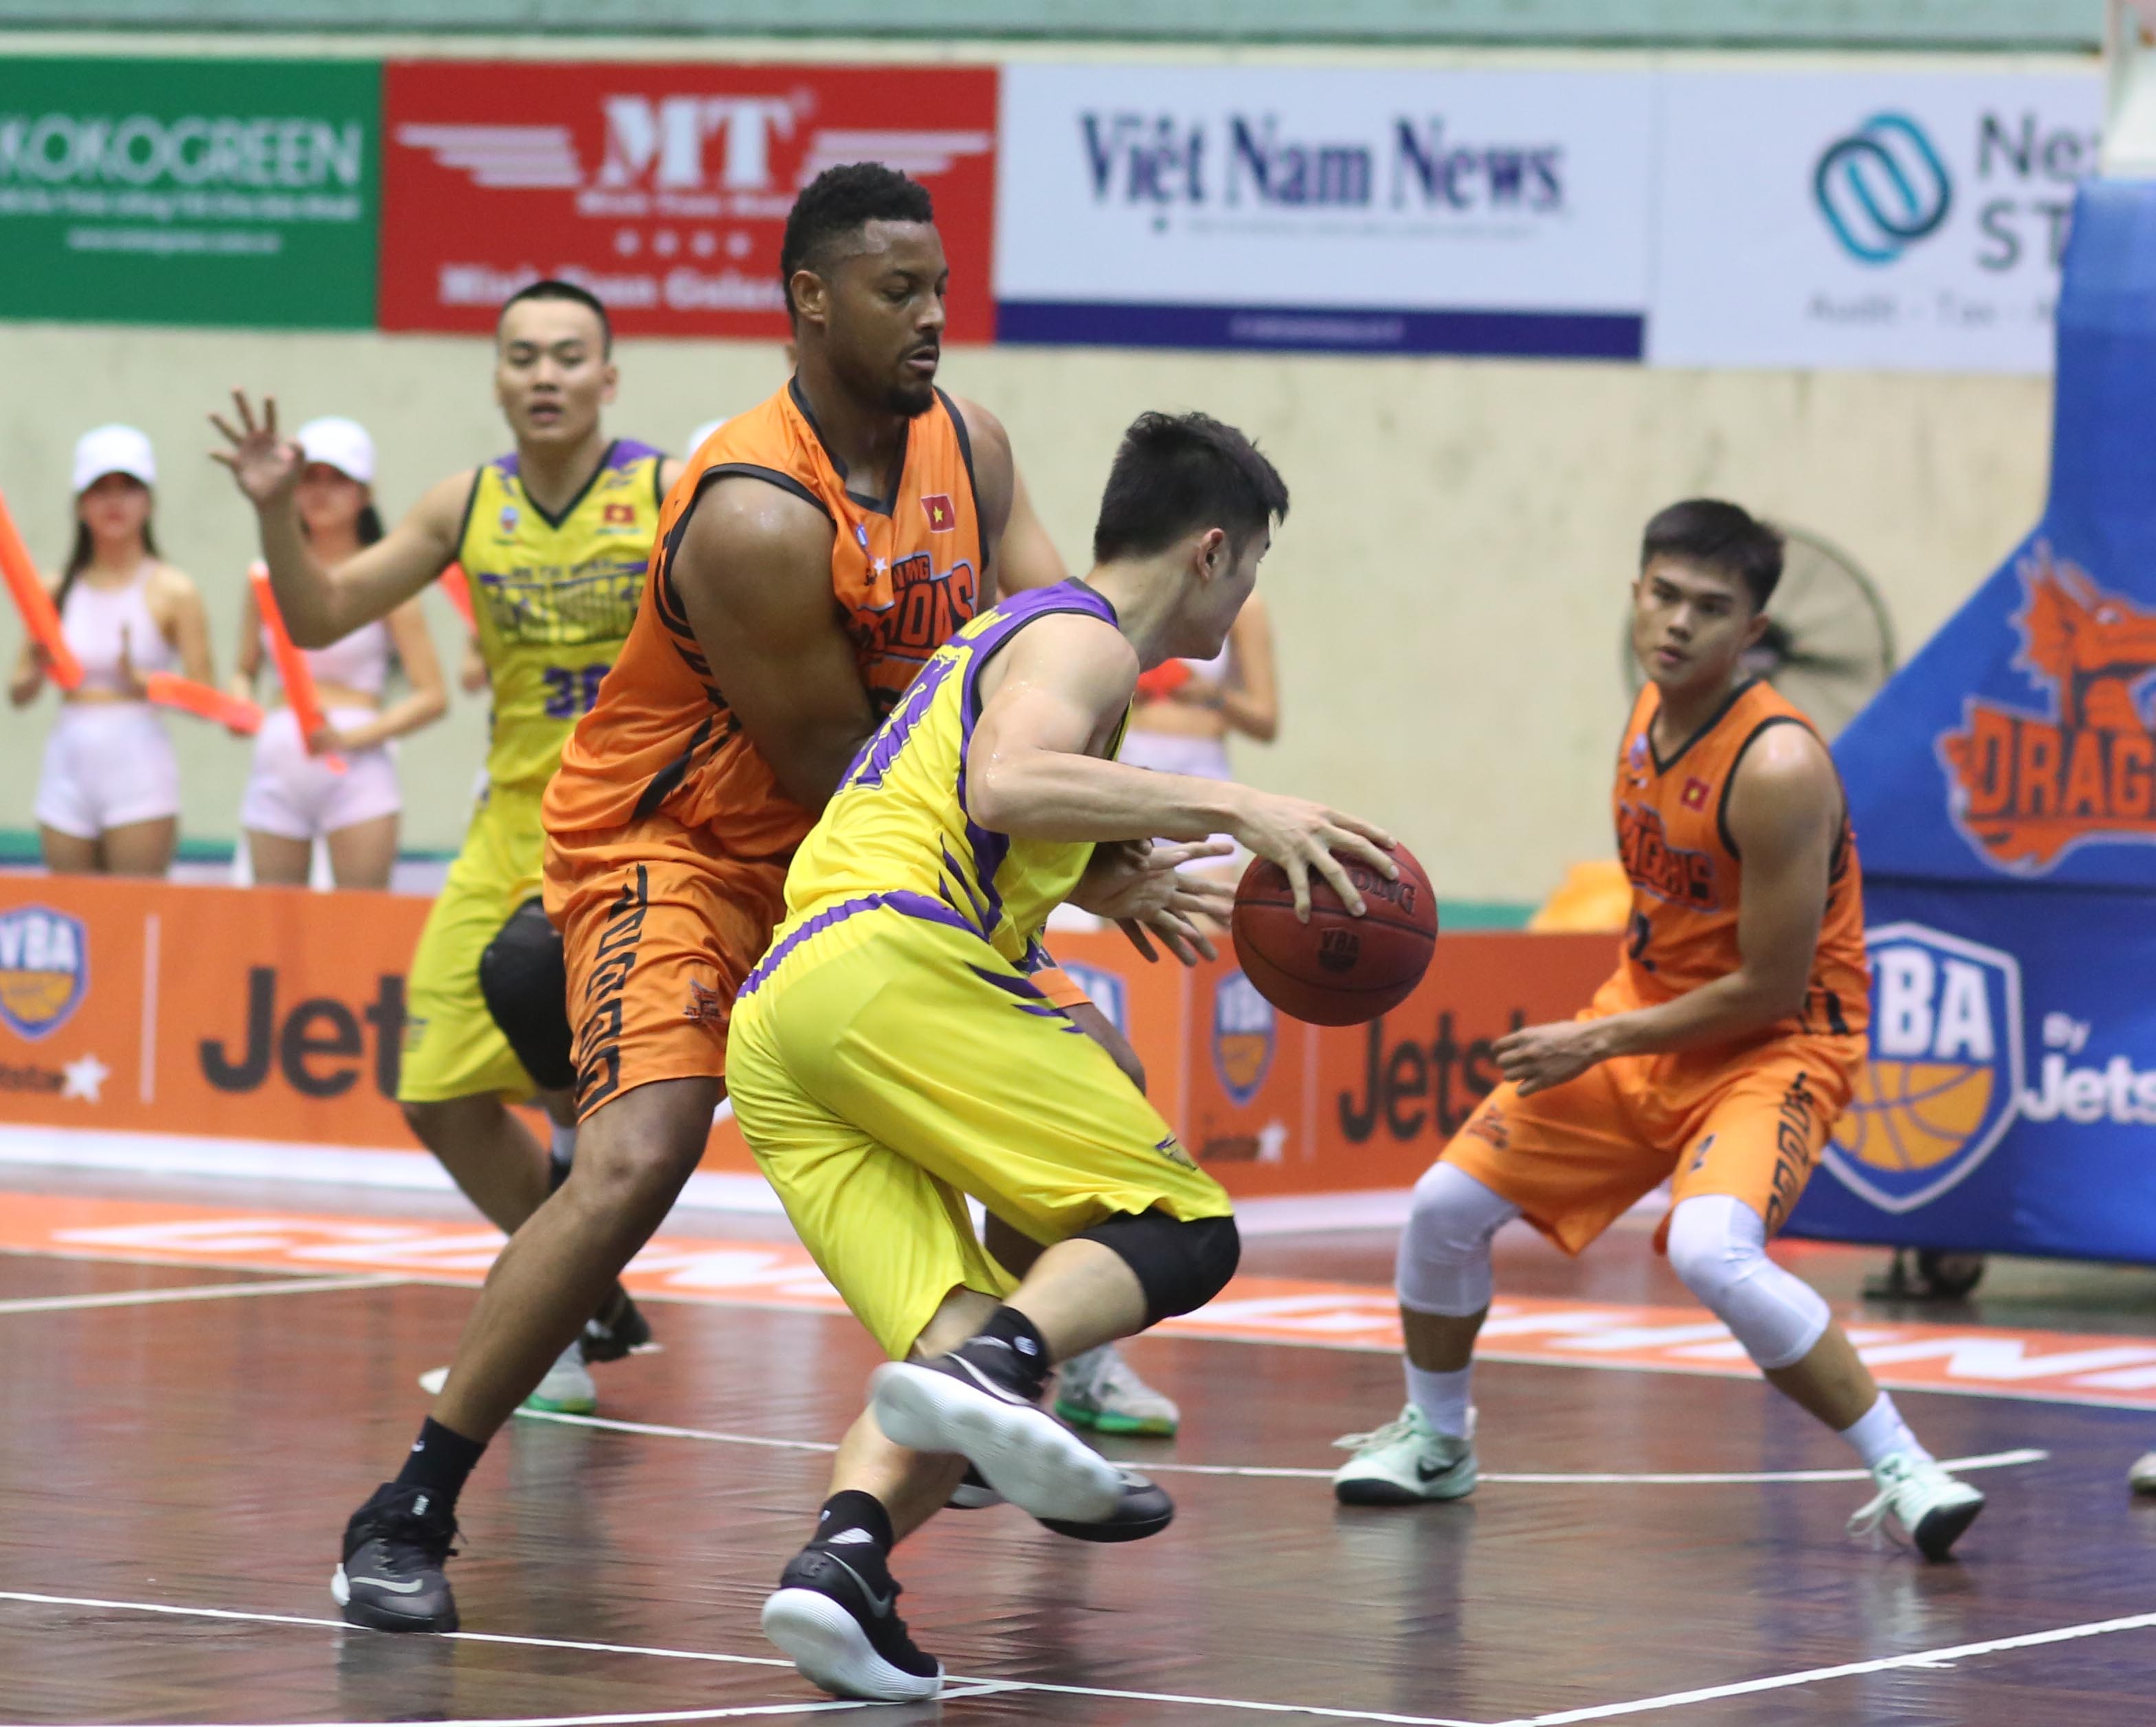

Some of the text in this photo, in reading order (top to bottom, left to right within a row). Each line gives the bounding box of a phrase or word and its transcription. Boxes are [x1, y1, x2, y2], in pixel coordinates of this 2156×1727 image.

[1224, 110, 1372, 209] Nam
[1390, 114, 1566, 213] News
[1871, 946, 1995, 1060] BA
